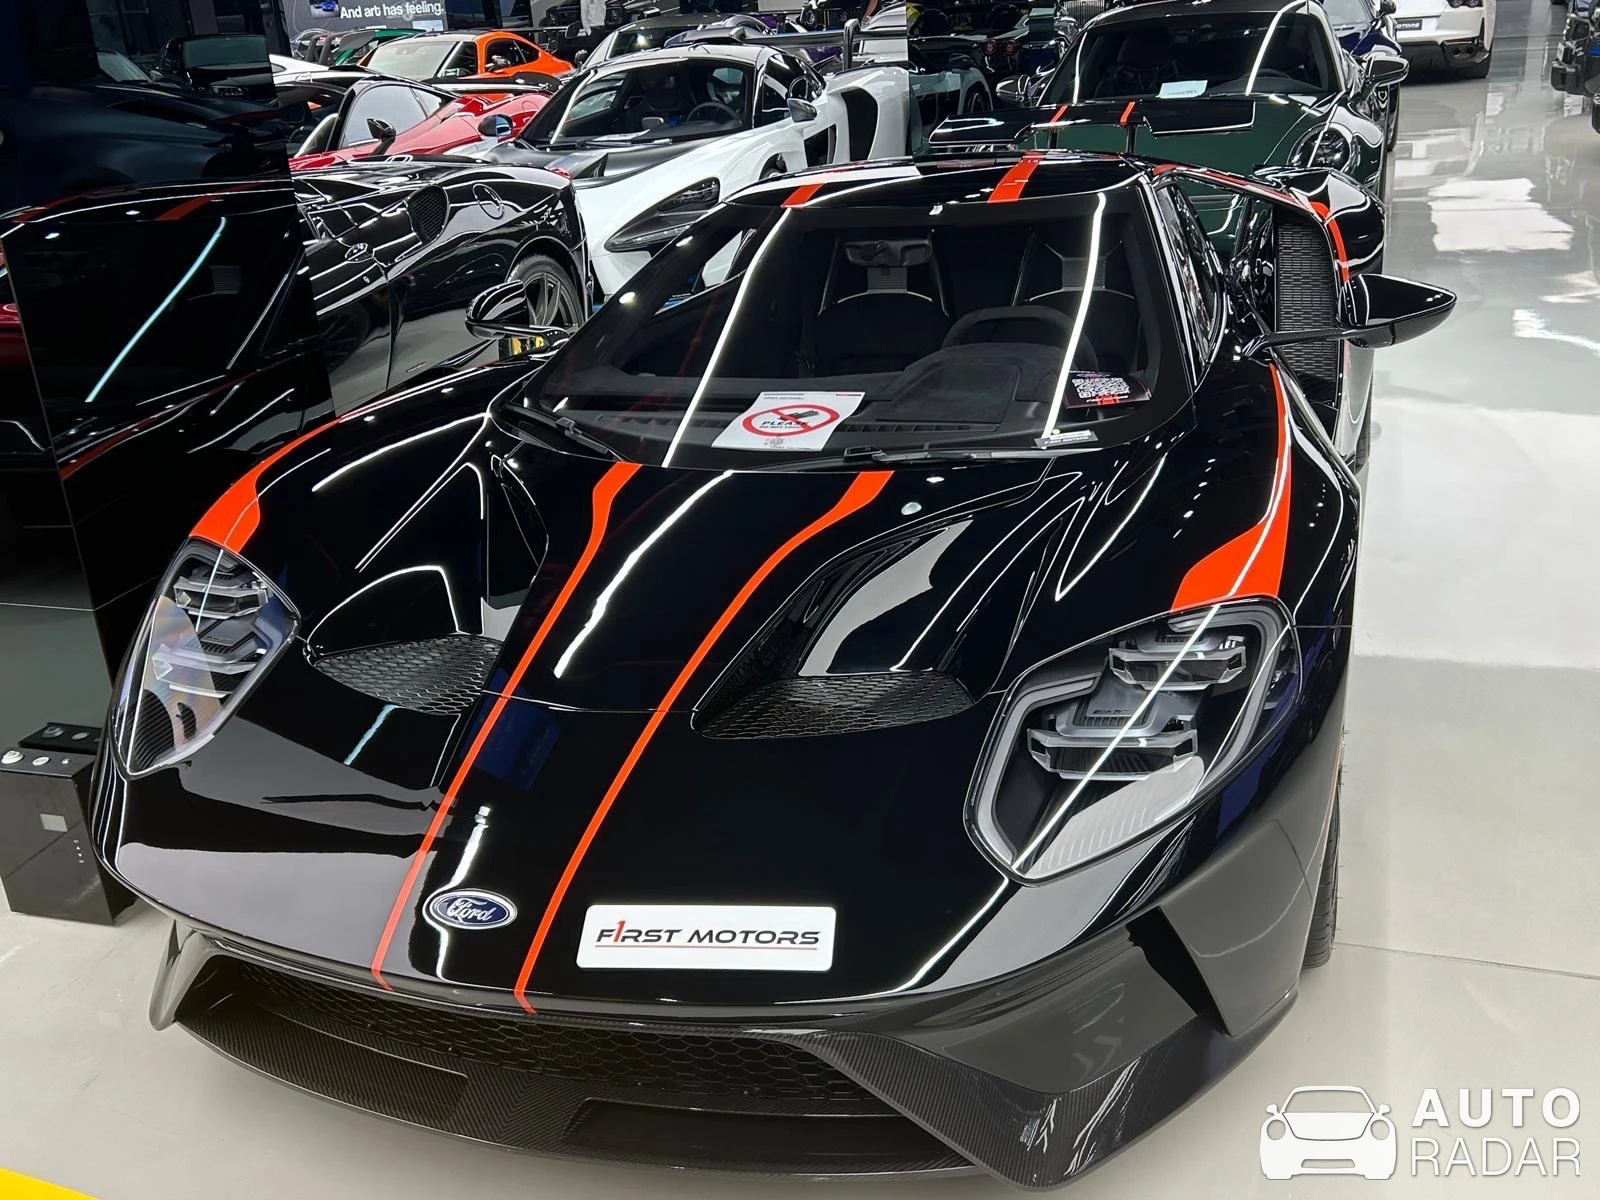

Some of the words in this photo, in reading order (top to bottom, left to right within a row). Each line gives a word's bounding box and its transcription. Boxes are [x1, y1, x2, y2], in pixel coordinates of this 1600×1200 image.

[340, 6, 362, 19] And
[364, 6, 381, 17] art
[382, 3, 403, 16] has
[404, 1, 444, 16] feeling.
[447, 897, 496, 923] Ford
[687, 929, 821, 945] MOTORS
